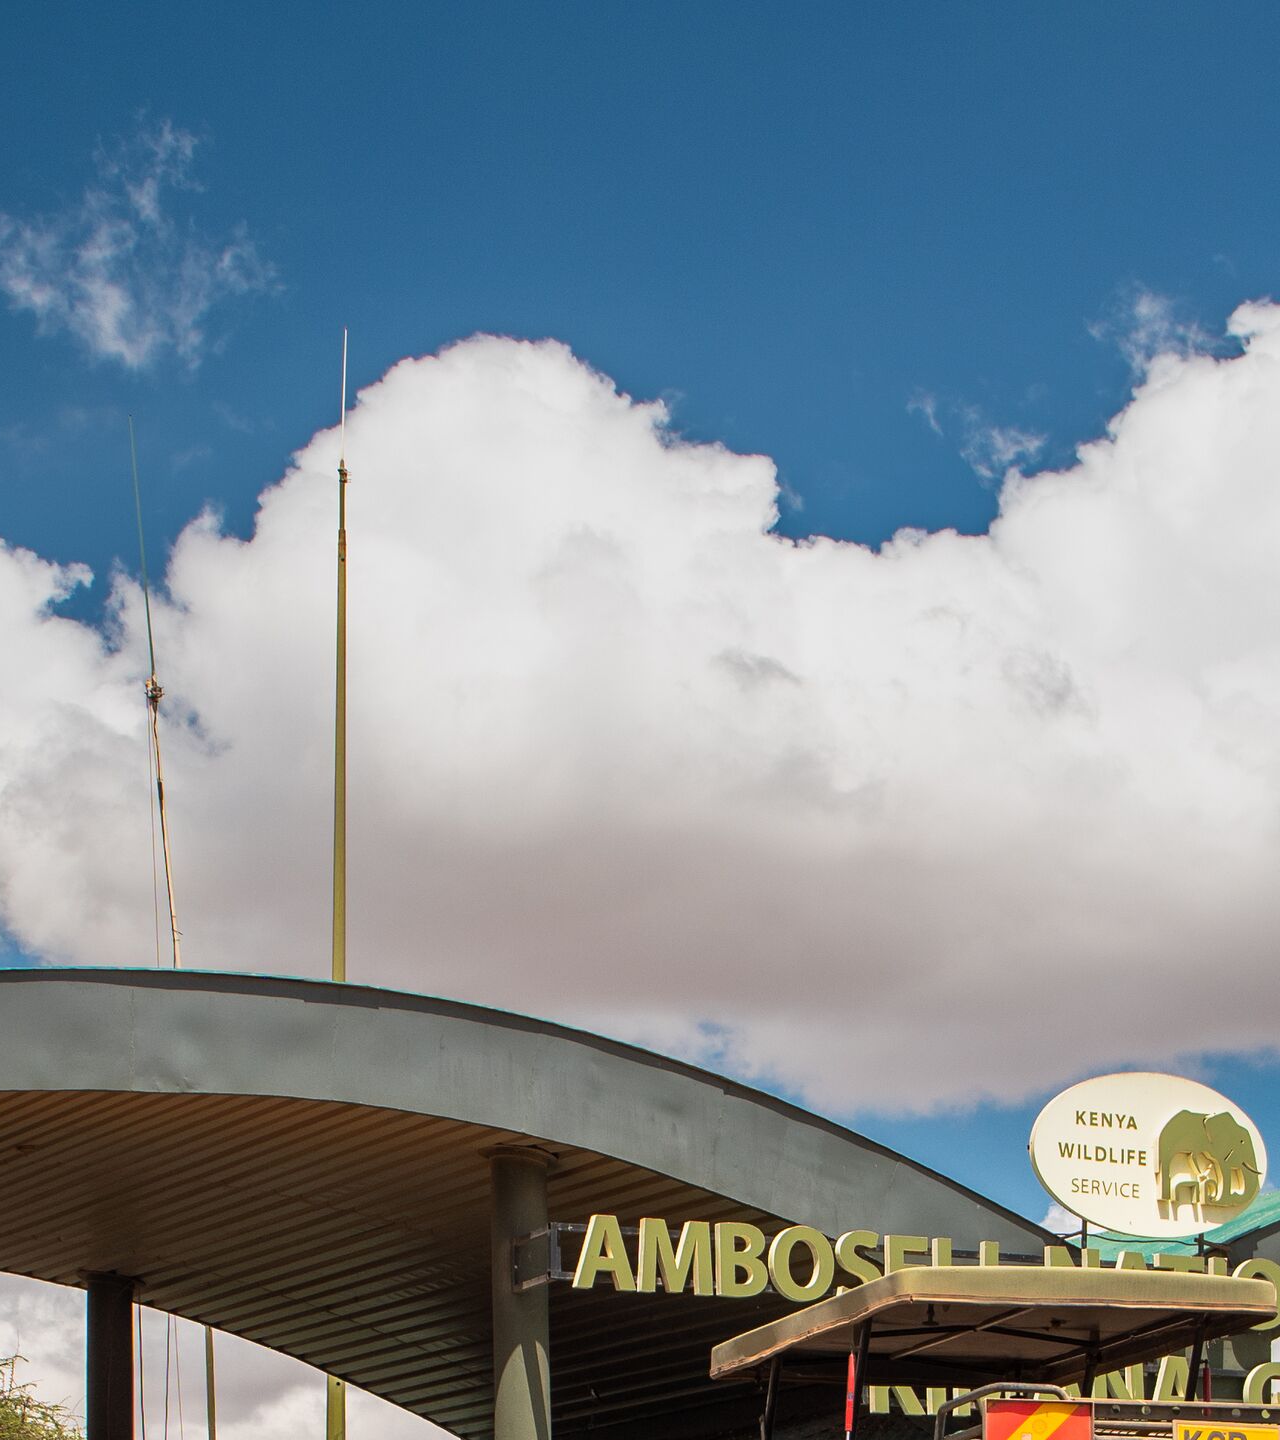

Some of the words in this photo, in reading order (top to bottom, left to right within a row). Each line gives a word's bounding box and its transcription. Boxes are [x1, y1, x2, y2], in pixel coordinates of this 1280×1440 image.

[1075, 1110, 1138, 1130] KENYA
[1058, 1142, 1147, 1166] WILDLIFE
[1071, 1177, 1140, 1199] SERVICE
